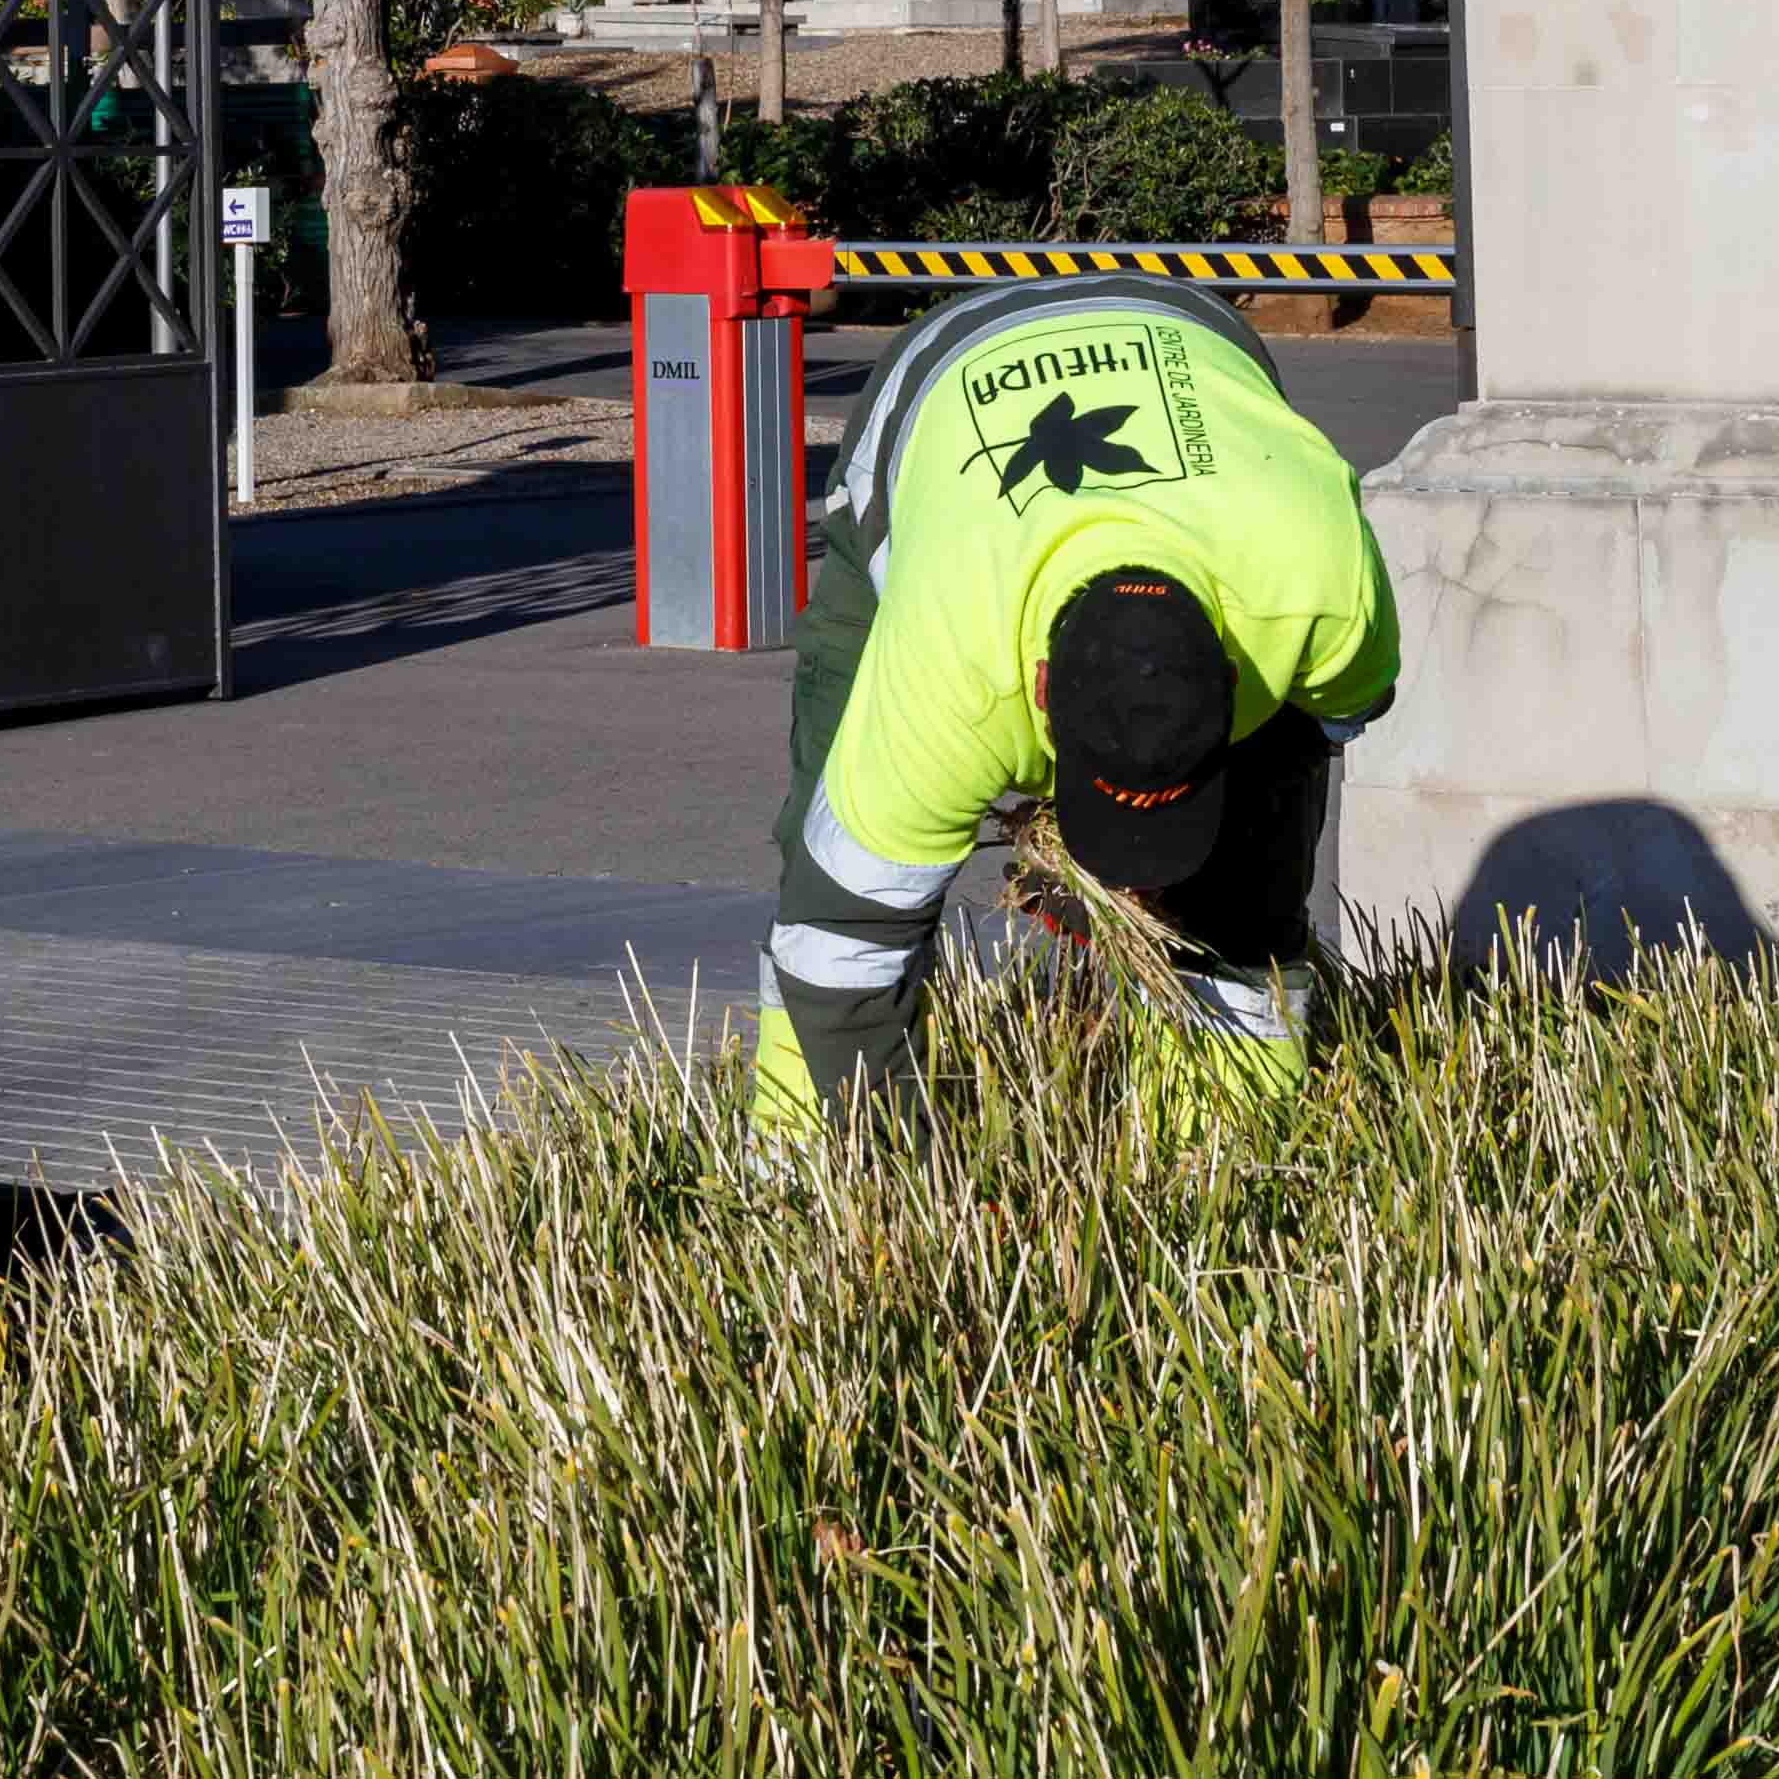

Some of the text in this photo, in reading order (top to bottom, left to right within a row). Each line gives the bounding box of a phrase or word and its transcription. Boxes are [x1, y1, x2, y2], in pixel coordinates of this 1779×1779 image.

[652, 361, 700, 379] DMIL
[972, 341, 1149, 406] L'HEURA
[1156, 325, 1218, 477] CENTRE DE JARDINERIA
